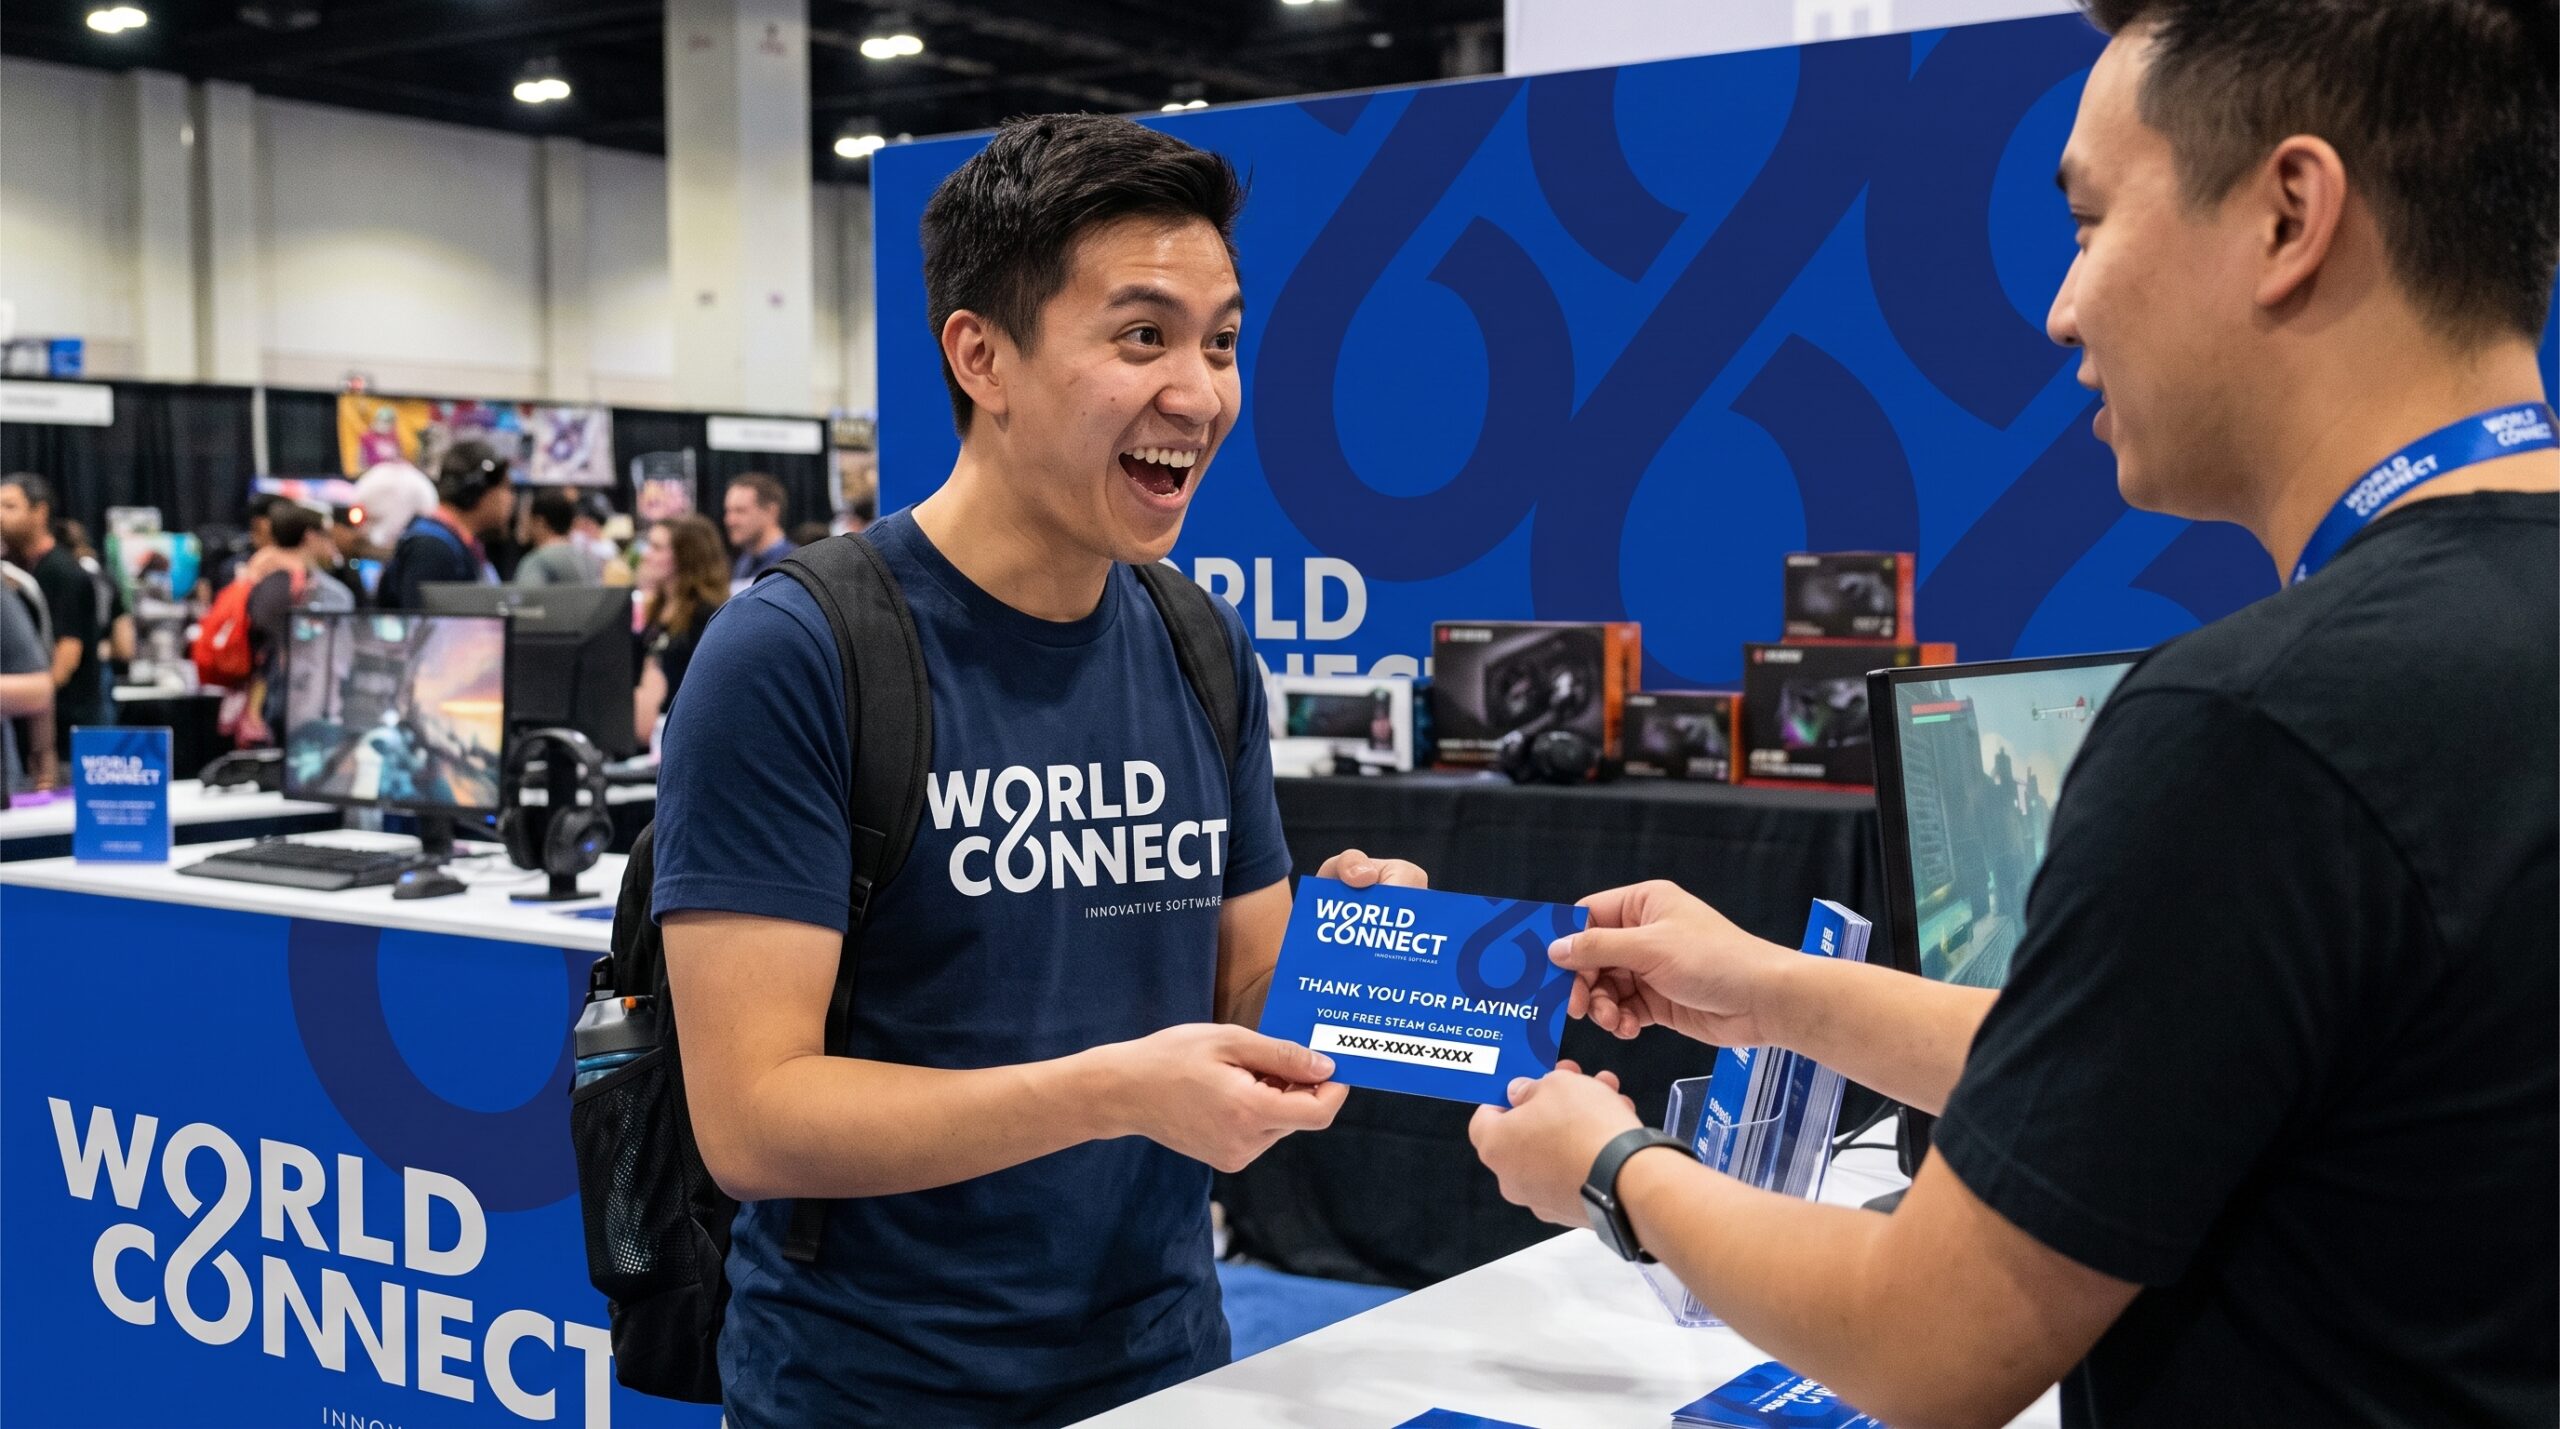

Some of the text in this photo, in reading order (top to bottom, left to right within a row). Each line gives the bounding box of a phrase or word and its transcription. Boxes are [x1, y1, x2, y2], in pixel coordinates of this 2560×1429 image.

[1158, 557, 1367, 641] RLD
[927, 760, 1166, 830] WORLD
[949, 818, 1228, 897] CONNECT
[1085, 895, 1222, 919] INNOVATIVE SOFTWARE
[1316, 898, 1415, 929] WORLD
[1317, 921, 1448, 956] CONNECT
[1298, 976, 1540, 1021] THANK YOU FOR PLAYING!
[1316, 1007, 1504, 1041] YOUR FREE STEAM GAME CODE:
[1336, 1033, 1474, 1065] XXXX-XXXX-XXXX
[48, 1096, 487, 1277] WORLD
[92, 1222, 612, 1429] CONNECT
